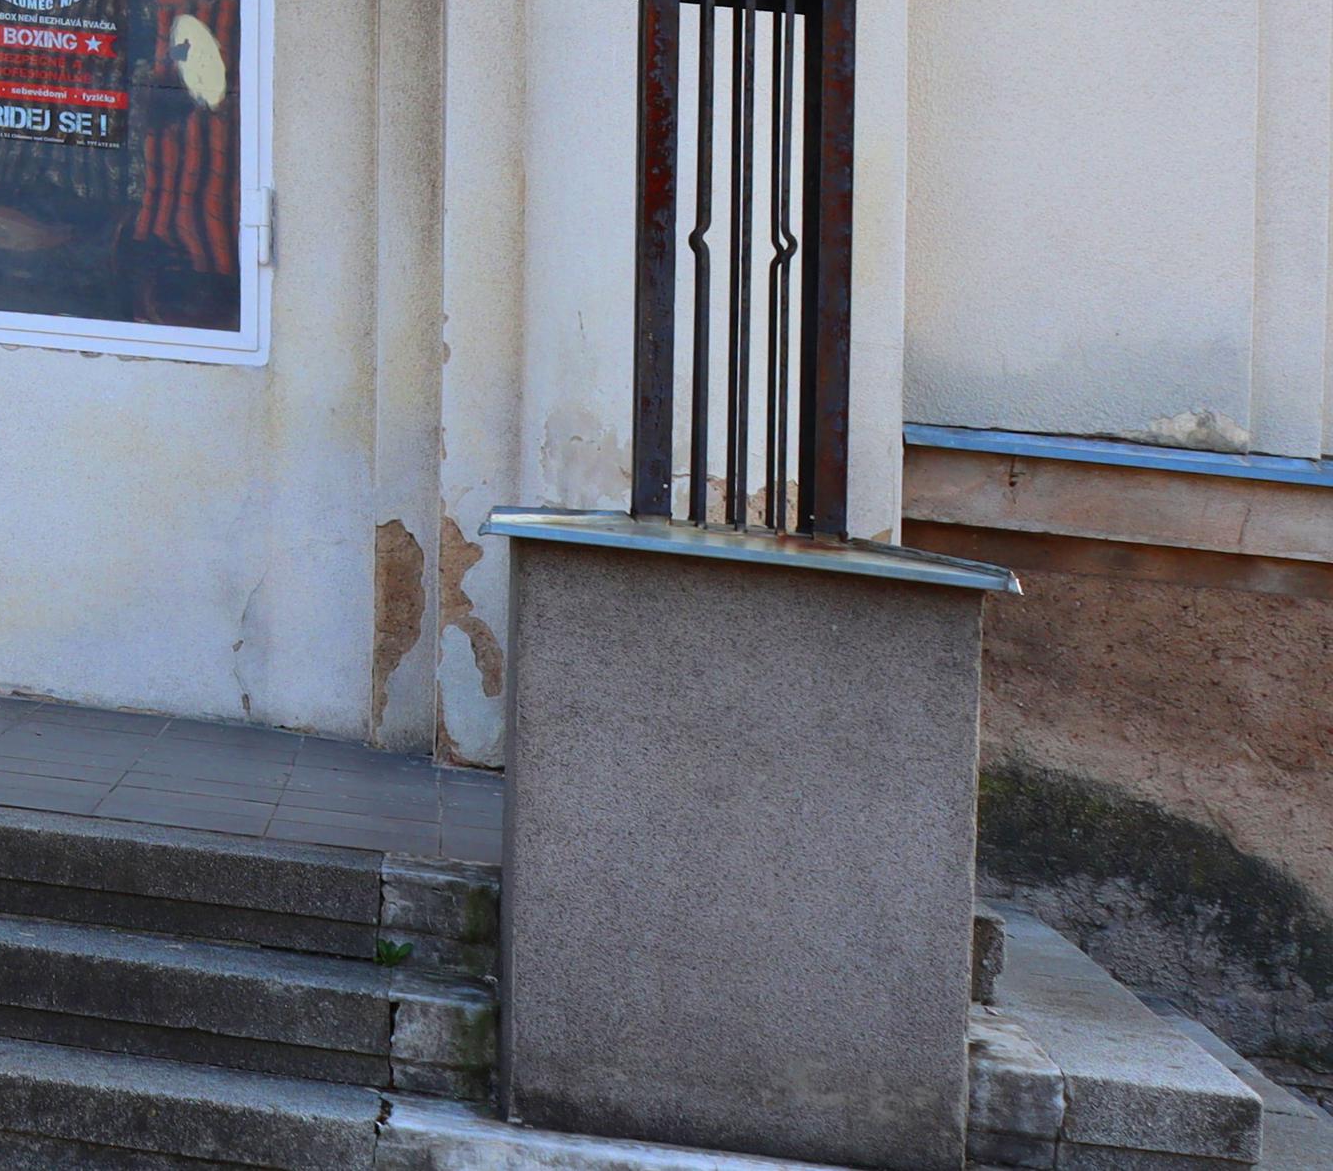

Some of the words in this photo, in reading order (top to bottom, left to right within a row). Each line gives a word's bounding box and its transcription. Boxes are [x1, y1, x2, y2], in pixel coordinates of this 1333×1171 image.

[0, 11, 17, 21] BOX
[18, 13, 38, 23] NENÍ
[39, 15, 82, 28] BEZHLAVÁ
[83, 18, 118, 31] RVAČKA
[2, 26, 79, 51] BOXING
[81, 91, 117, 104] fyzička
[58, 110, 93, 136] SE
